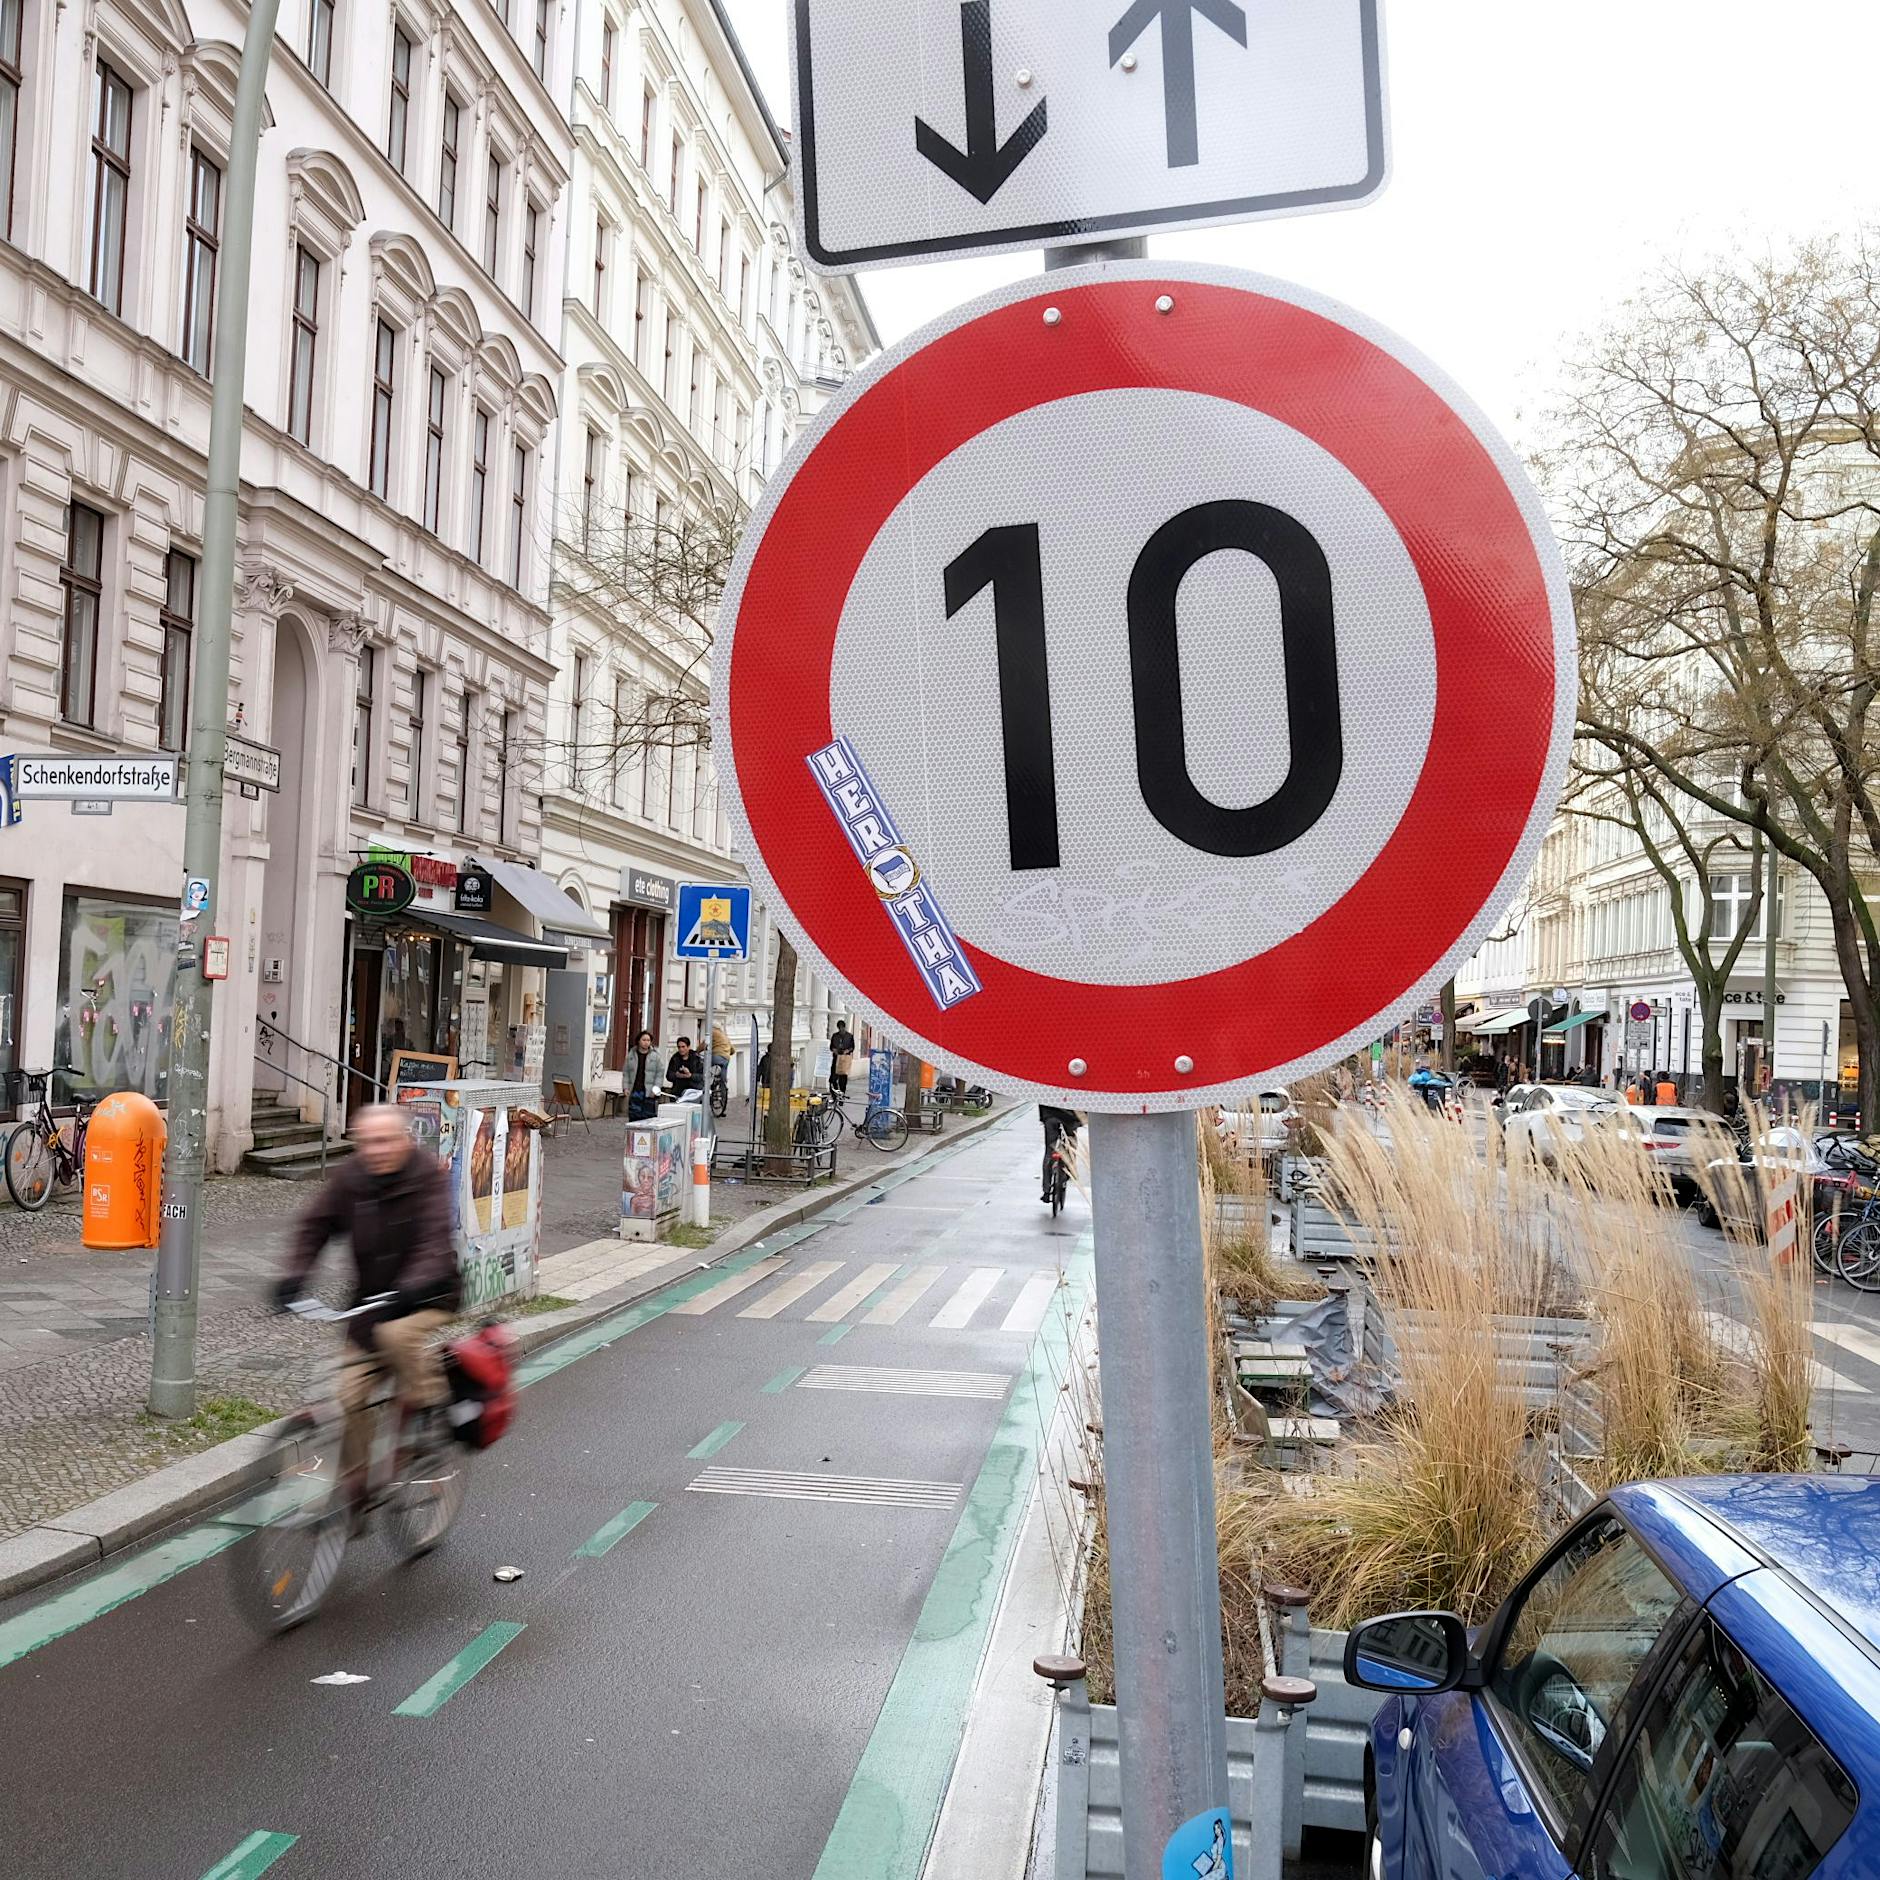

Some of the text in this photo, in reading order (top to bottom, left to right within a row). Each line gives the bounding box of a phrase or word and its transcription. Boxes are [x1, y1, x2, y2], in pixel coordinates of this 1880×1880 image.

[943, 499, 1344, 871] 10
[22, 763, 171, 792] Schenkendorfstraße
[362, 875, 396, 900] PR
[646, 878, 670, 905] clothing
[1724, 991, 1785, 1004] ce & te
[92, 1187, 108, 1202] BSR
